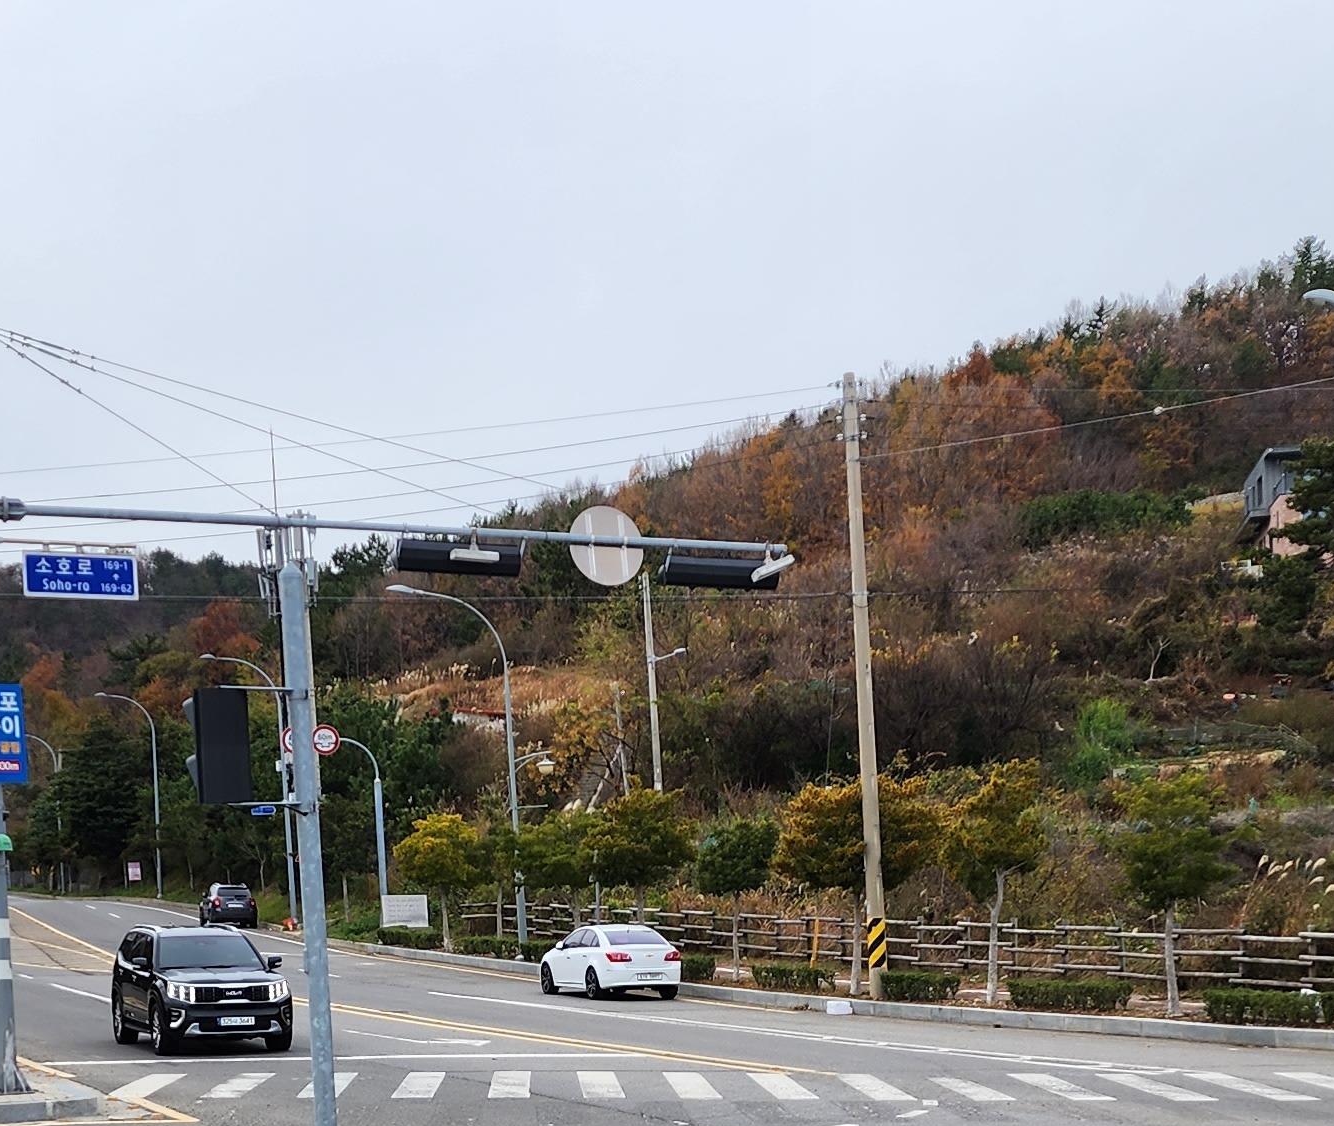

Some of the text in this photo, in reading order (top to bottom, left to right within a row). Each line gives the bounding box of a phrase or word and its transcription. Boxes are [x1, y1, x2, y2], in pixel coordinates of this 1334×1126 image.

[34, 557, 94, 576] 소호로
[102, 560, 128, 571] 169-1
[42, 577, 90, 592] Soho-ro
[100, 582, 132, 593] 169-62
